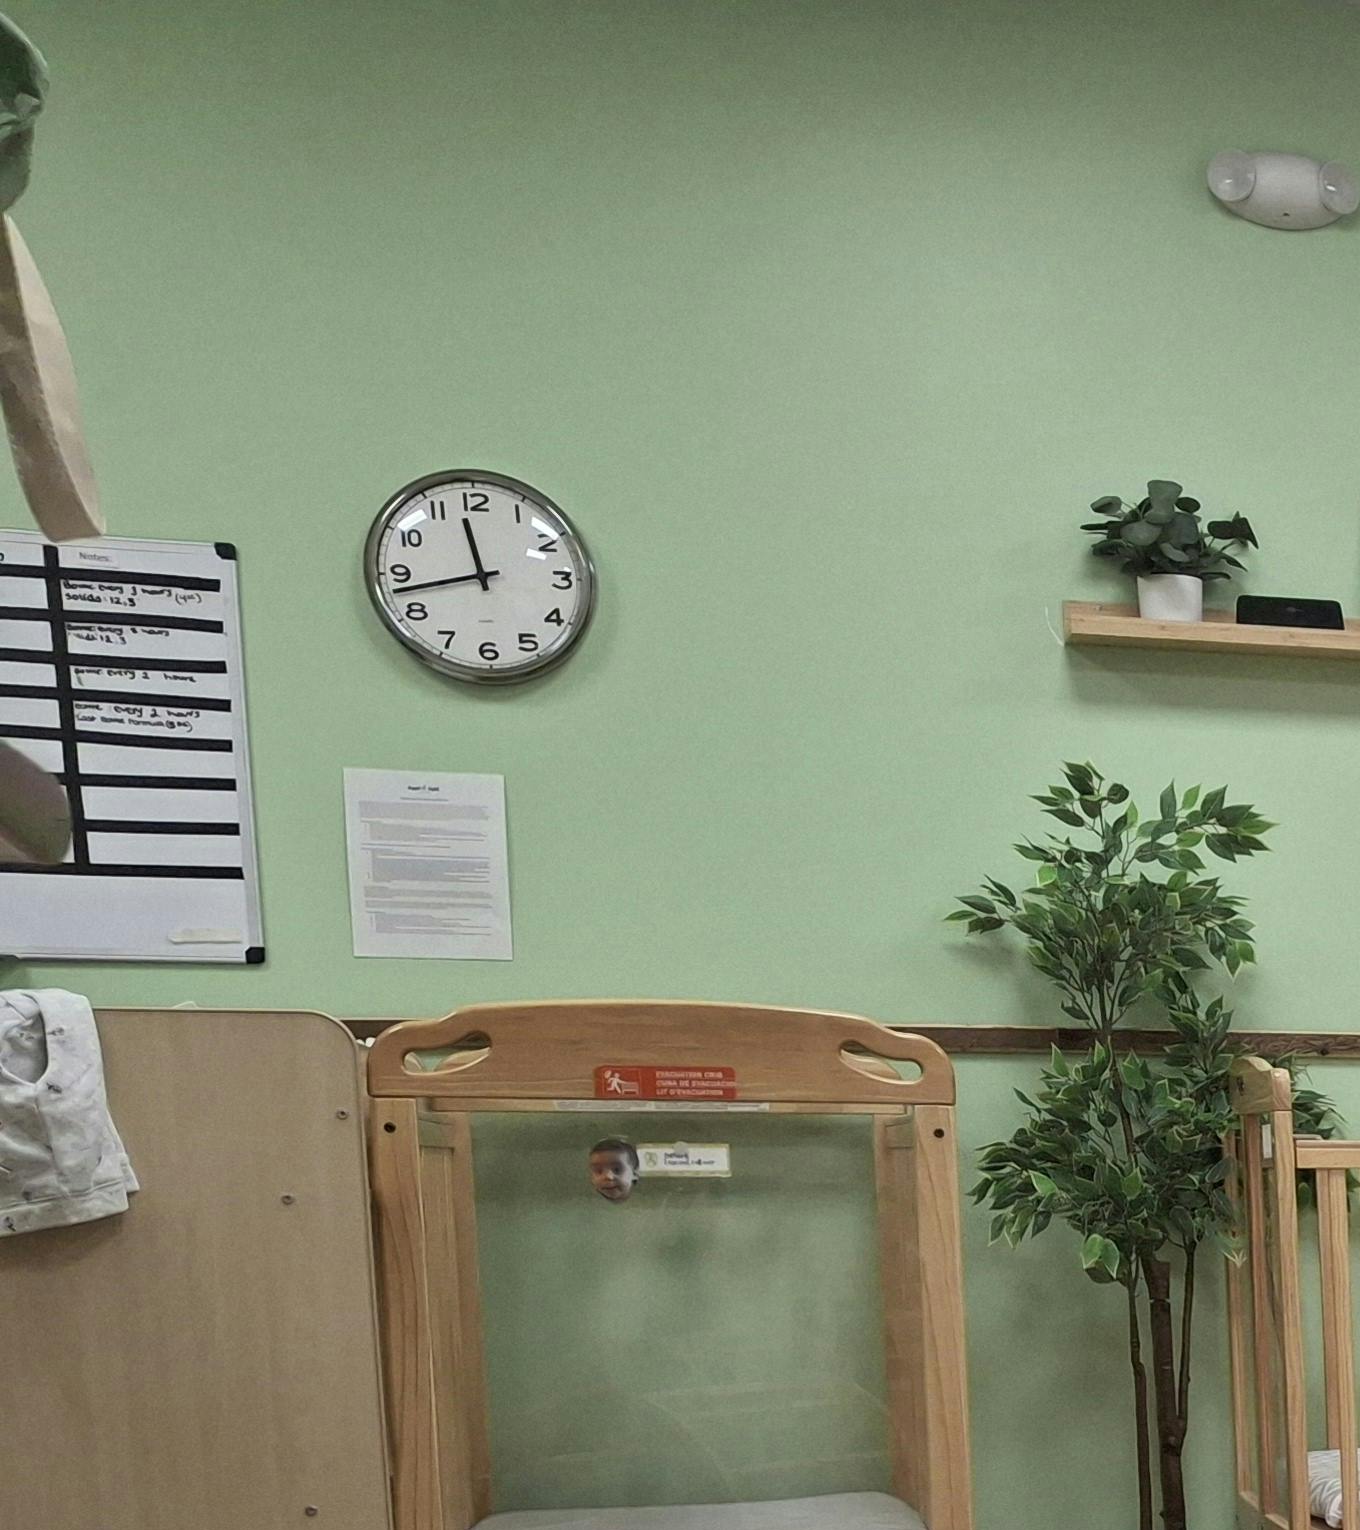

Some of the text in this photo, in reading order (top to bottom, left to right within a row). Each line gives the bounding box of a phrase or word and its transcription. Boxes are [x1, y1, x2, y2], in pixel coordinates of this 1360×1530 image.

[430, 500, 446, 521] 11
[463, 492, 490, 512] 12
[514, 504, 521, 524] 1
[401, 529, 423, 548] 10
[537, 533, 558, 553] 2
[390, 564, 412, 583] 9
[552, 570, 573, 590] 3
[405, 602, 429, 621] 8
[544, 608, 565, 627] 4
[437, 631, 456, 649] 7
[518, 633, 539, 652] 5
[478, 642, 500, 661] 6
